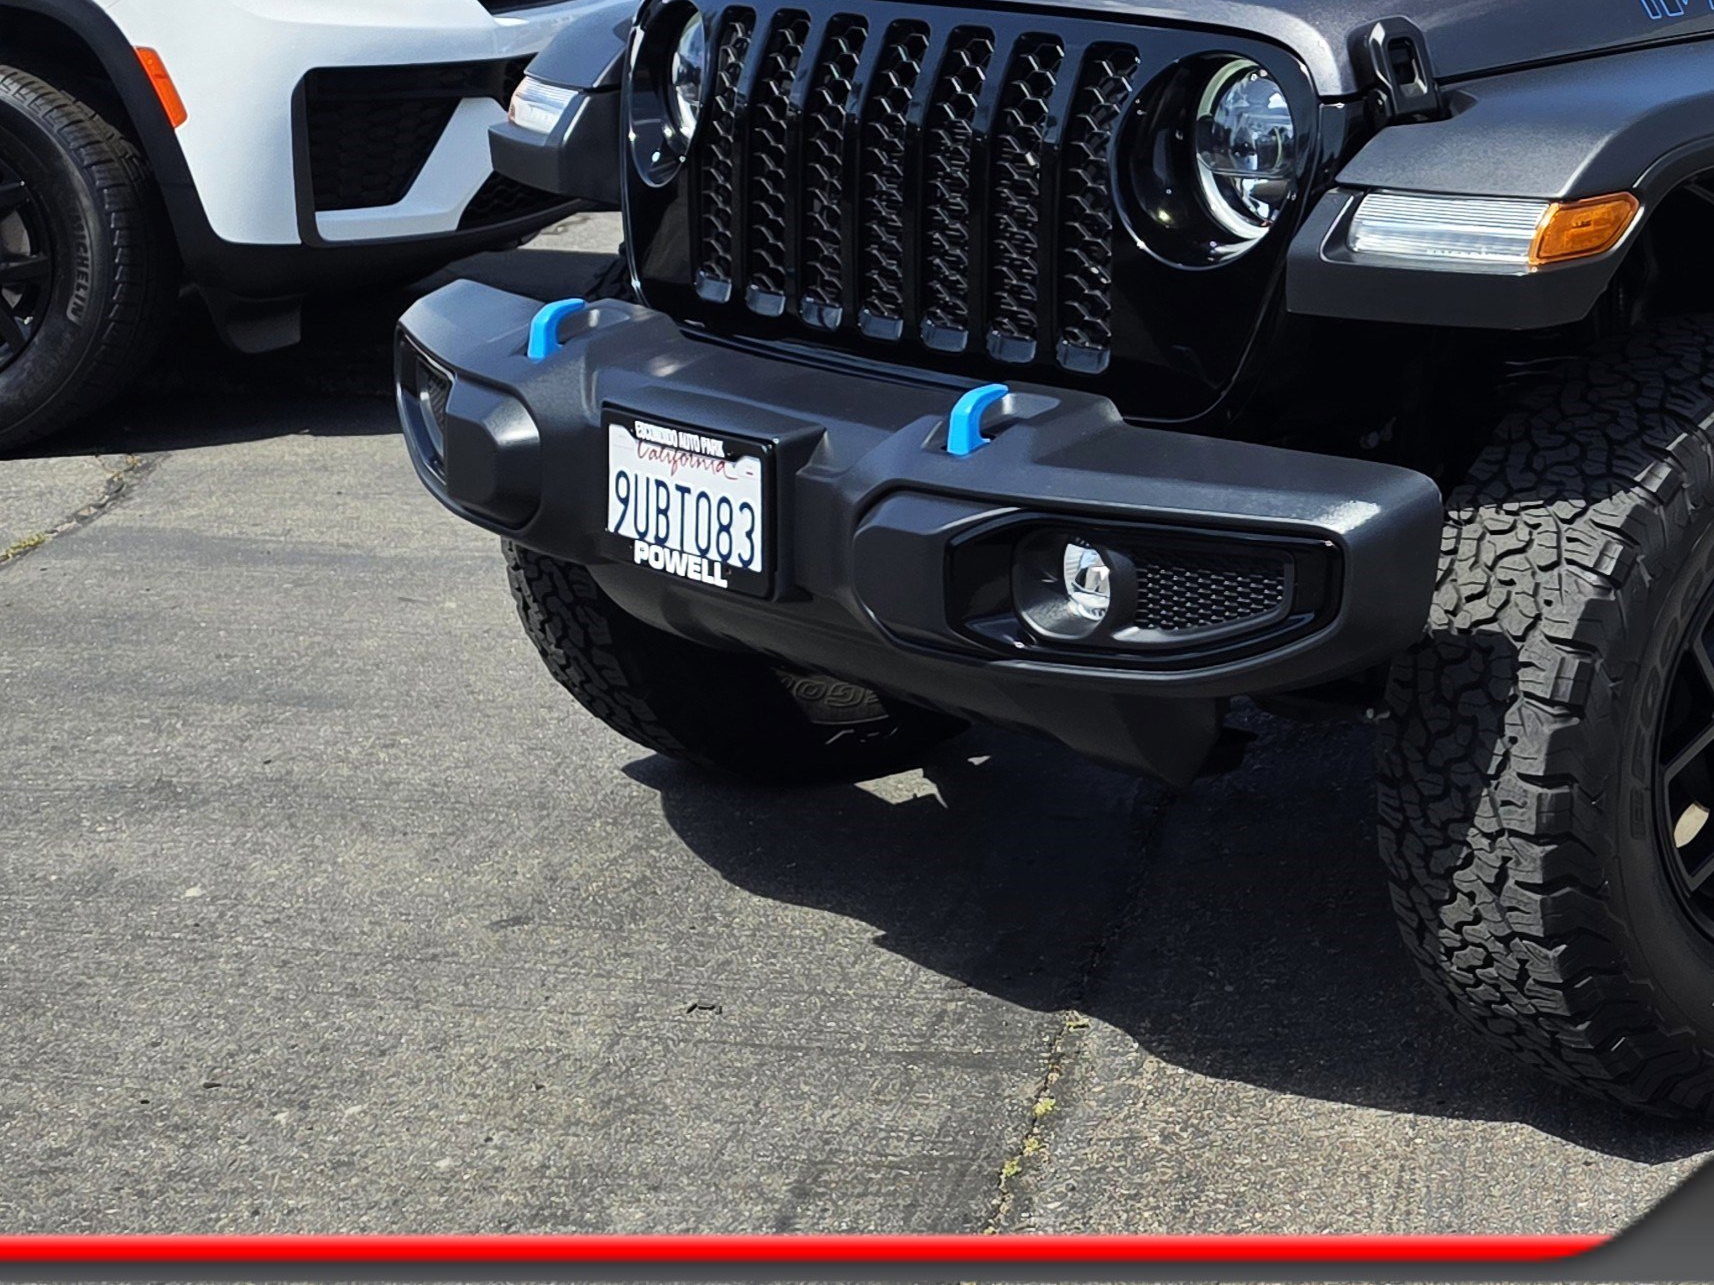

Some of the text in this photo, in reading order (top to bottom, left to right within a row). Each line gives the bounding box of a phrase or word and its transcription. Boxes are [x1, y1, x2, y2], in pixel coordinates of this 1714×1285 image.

[637, 440, 739, 481] California
[614, 469, 756, 569] 9UBT083
[633, 539, 729, 589] POWELL
